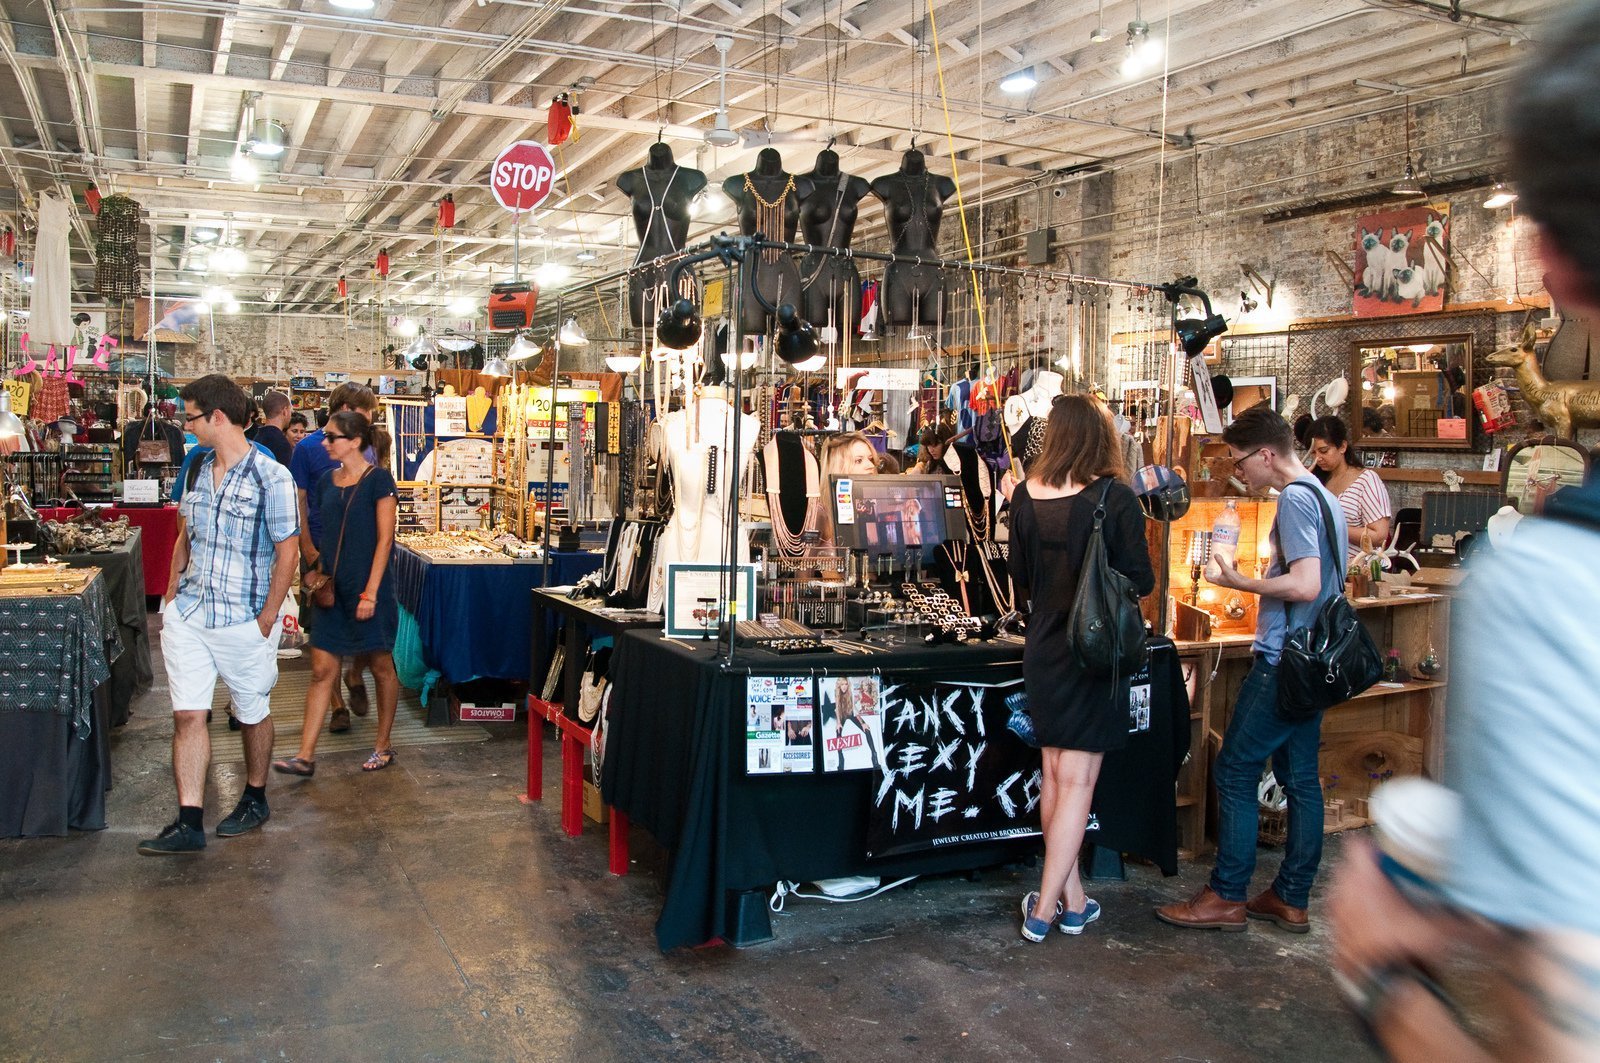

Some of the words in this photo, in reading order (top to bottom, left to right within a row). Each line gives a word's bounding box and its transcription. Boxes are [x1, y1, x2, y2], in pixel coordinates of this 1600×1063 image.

[496, 161, 551, 191] STOP
[14, 332, 118, 388] SALE
[749, 695, 771, 703] VOICE
[470, 709, 505, 717] TOMATOES
[880, 682, 986, 742] FANCY
[783, 752, 811, 760] ACCESSORIES
[875, 738, 988, 808] SEXY
[932, 835, 959, 846] JEWELRY
[960, 832, 989, 842] CREATED
[989, 830, 998, 838] IN
[999, 826, 1033, 837] BROOKLYN
